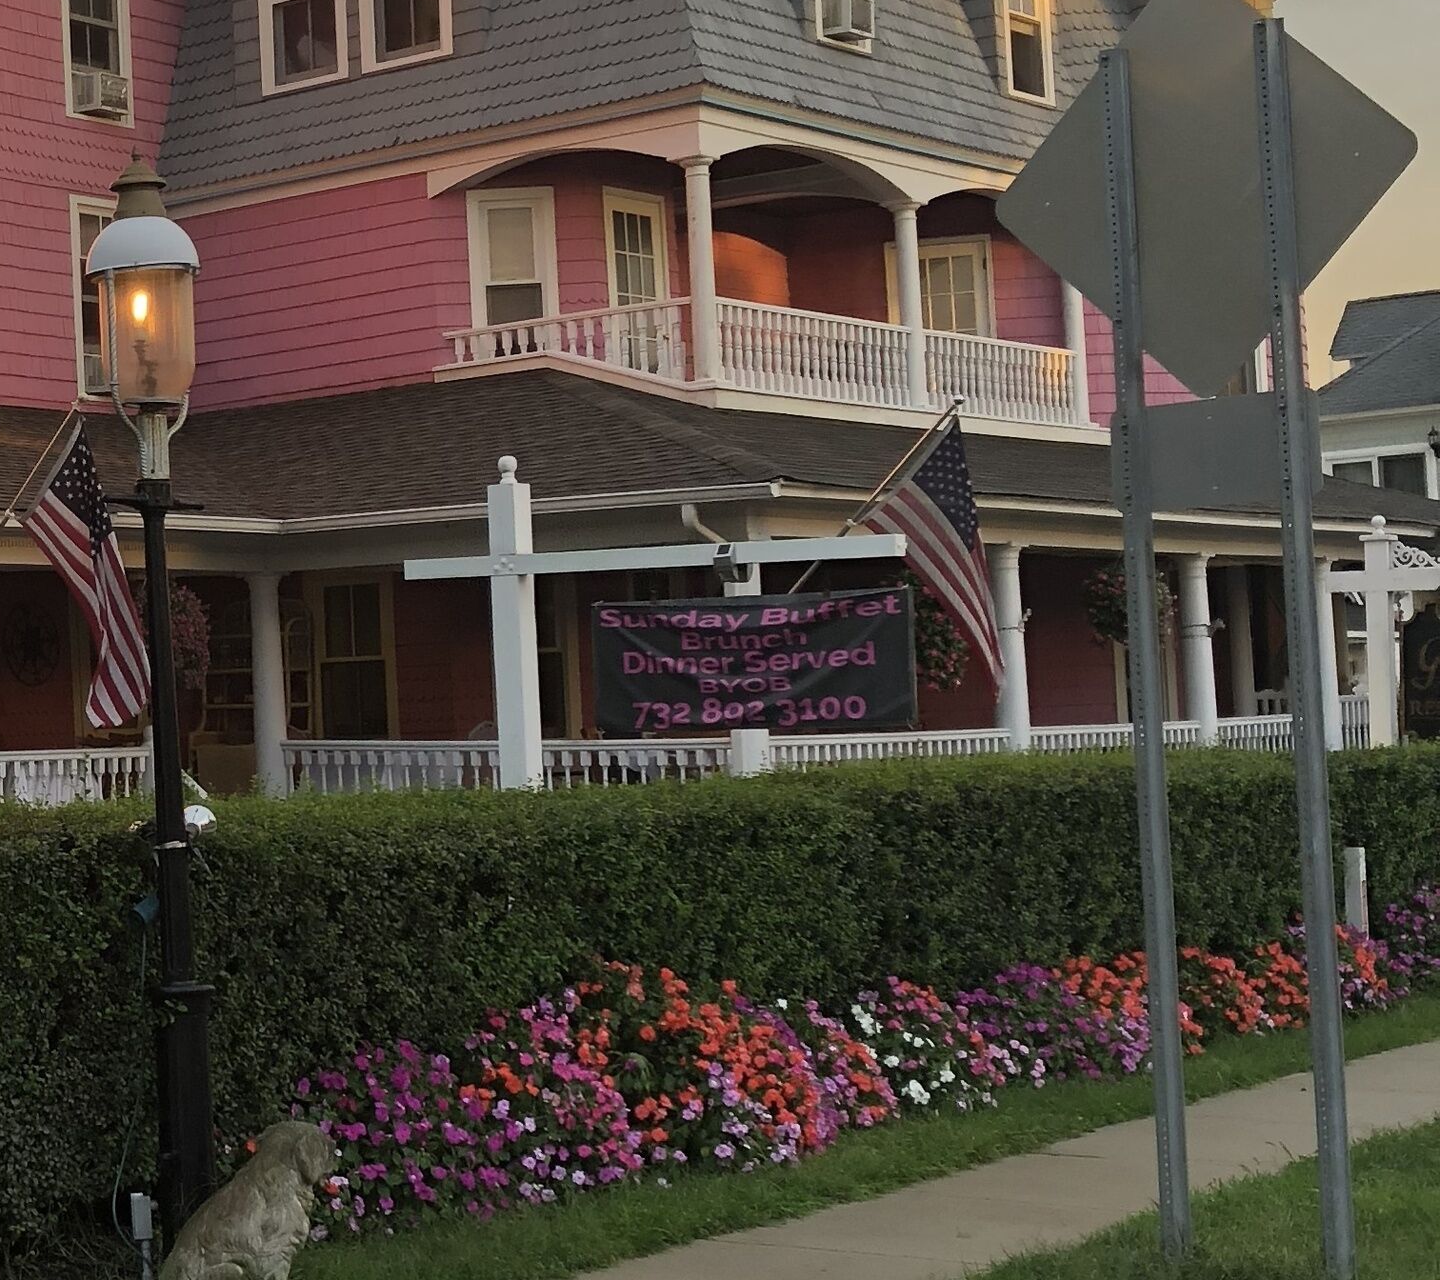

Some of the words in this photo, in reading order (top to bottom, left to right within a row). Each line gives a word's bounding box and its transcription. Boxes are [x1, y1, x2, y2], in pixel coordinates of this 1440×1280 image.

[599, 608, 750, 632] Sunday
[760, 594, 902, 626] Buffet
[681, 628, 808, 651] Brunch
[622, 651, 735, 675] Dinner
[744, 640, 877, 673] Served
[699, 676, 792, 694] BYOB
[632, 701, 691, 729] 732
[776, 695, 867, 727] 3100
